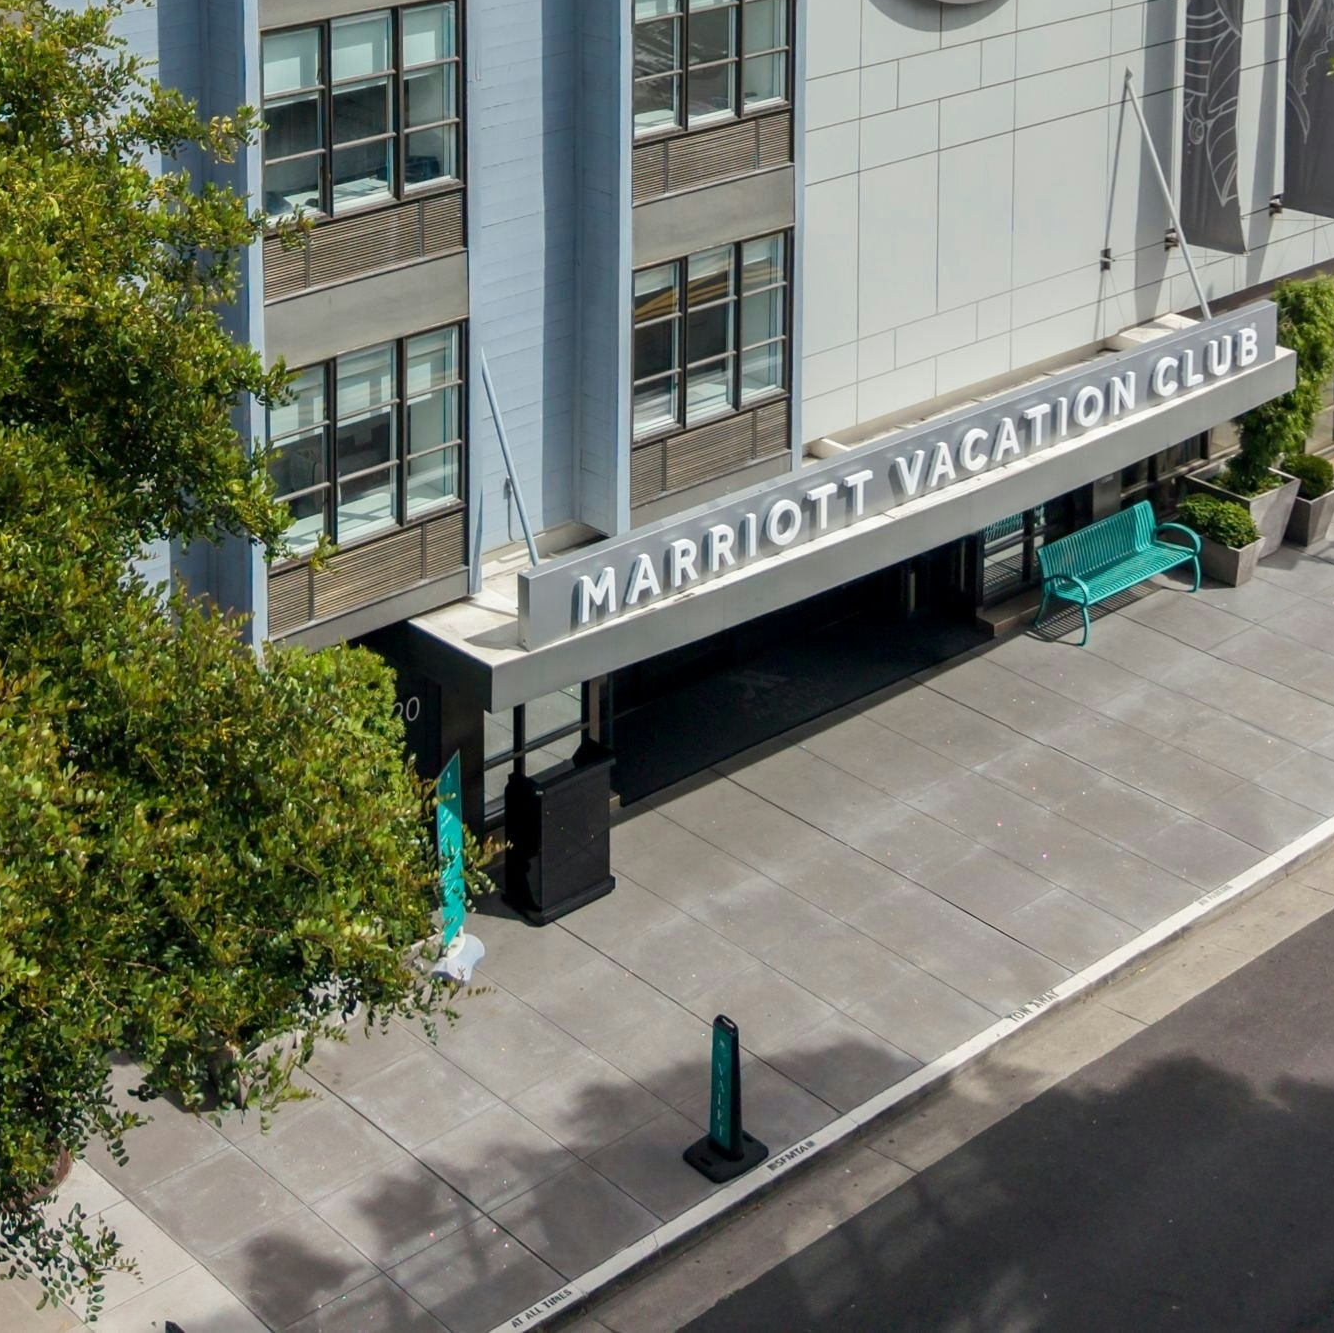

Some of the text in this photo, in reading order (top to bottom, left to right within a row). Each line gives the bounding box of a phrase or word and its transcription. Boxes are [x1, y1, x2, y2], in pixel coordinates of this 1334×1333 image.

[578, 327, 1259, 624] MARRIOTT VACATION CLUB
[1007, 988, 1060, 1023] TOW AWAY
[774, 1145, 809, 1167] SFMTA
[511, 1288, 573, 1328] AT ALL TIMES
